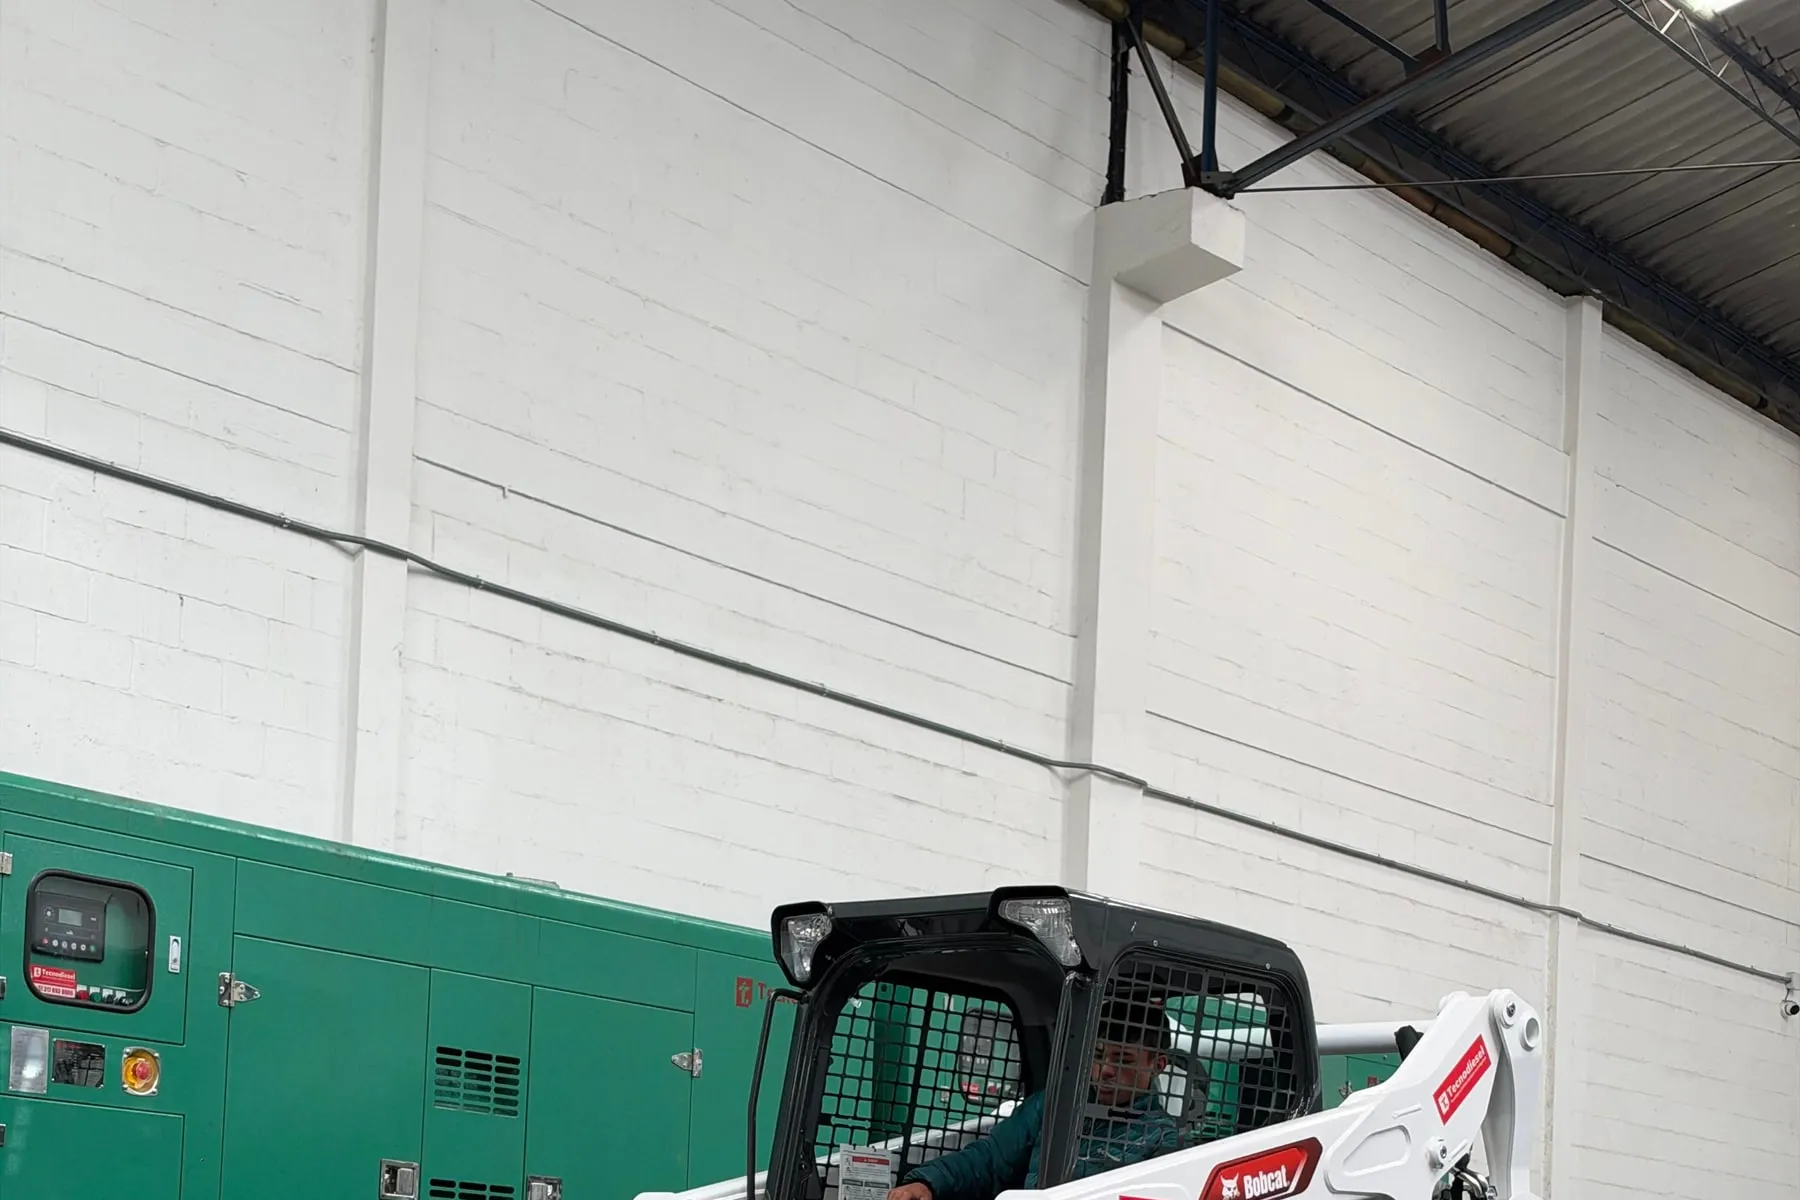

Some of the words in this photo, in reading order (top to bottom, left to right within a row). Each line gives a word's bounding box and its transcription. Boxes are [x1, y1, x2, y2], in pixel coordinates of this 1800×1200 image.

[42, 968, 75, 979] Tecnodiesel
[1446, 1045, 1485, 1096] Tecnodiesel
[1243, 1164, 1288, 1200] Bobcat
